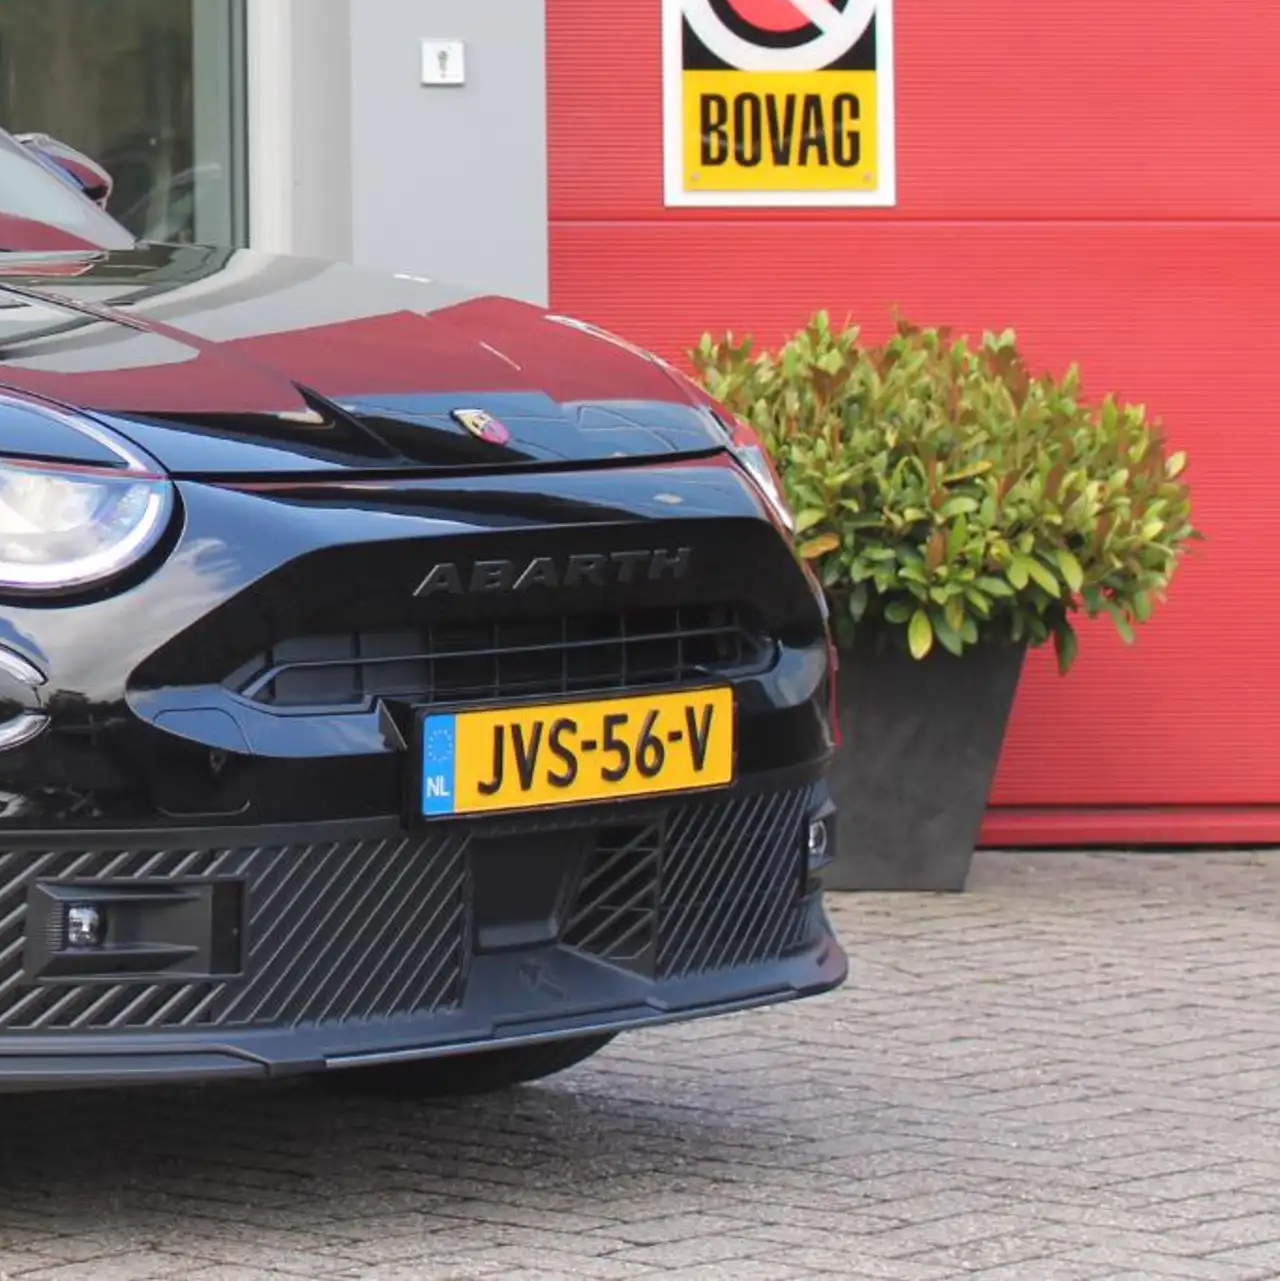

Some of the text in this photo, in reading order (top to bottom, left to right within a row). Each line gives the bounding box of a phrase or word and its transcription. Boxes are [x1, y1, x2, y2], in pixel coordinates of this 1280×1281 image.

[699, 91, 861, 168] BOVAG
[412, 546, 692, 597] ABARTH
[477, 703, 714, 796] JVS-56-V
[426, 774, 450, 799] NL
